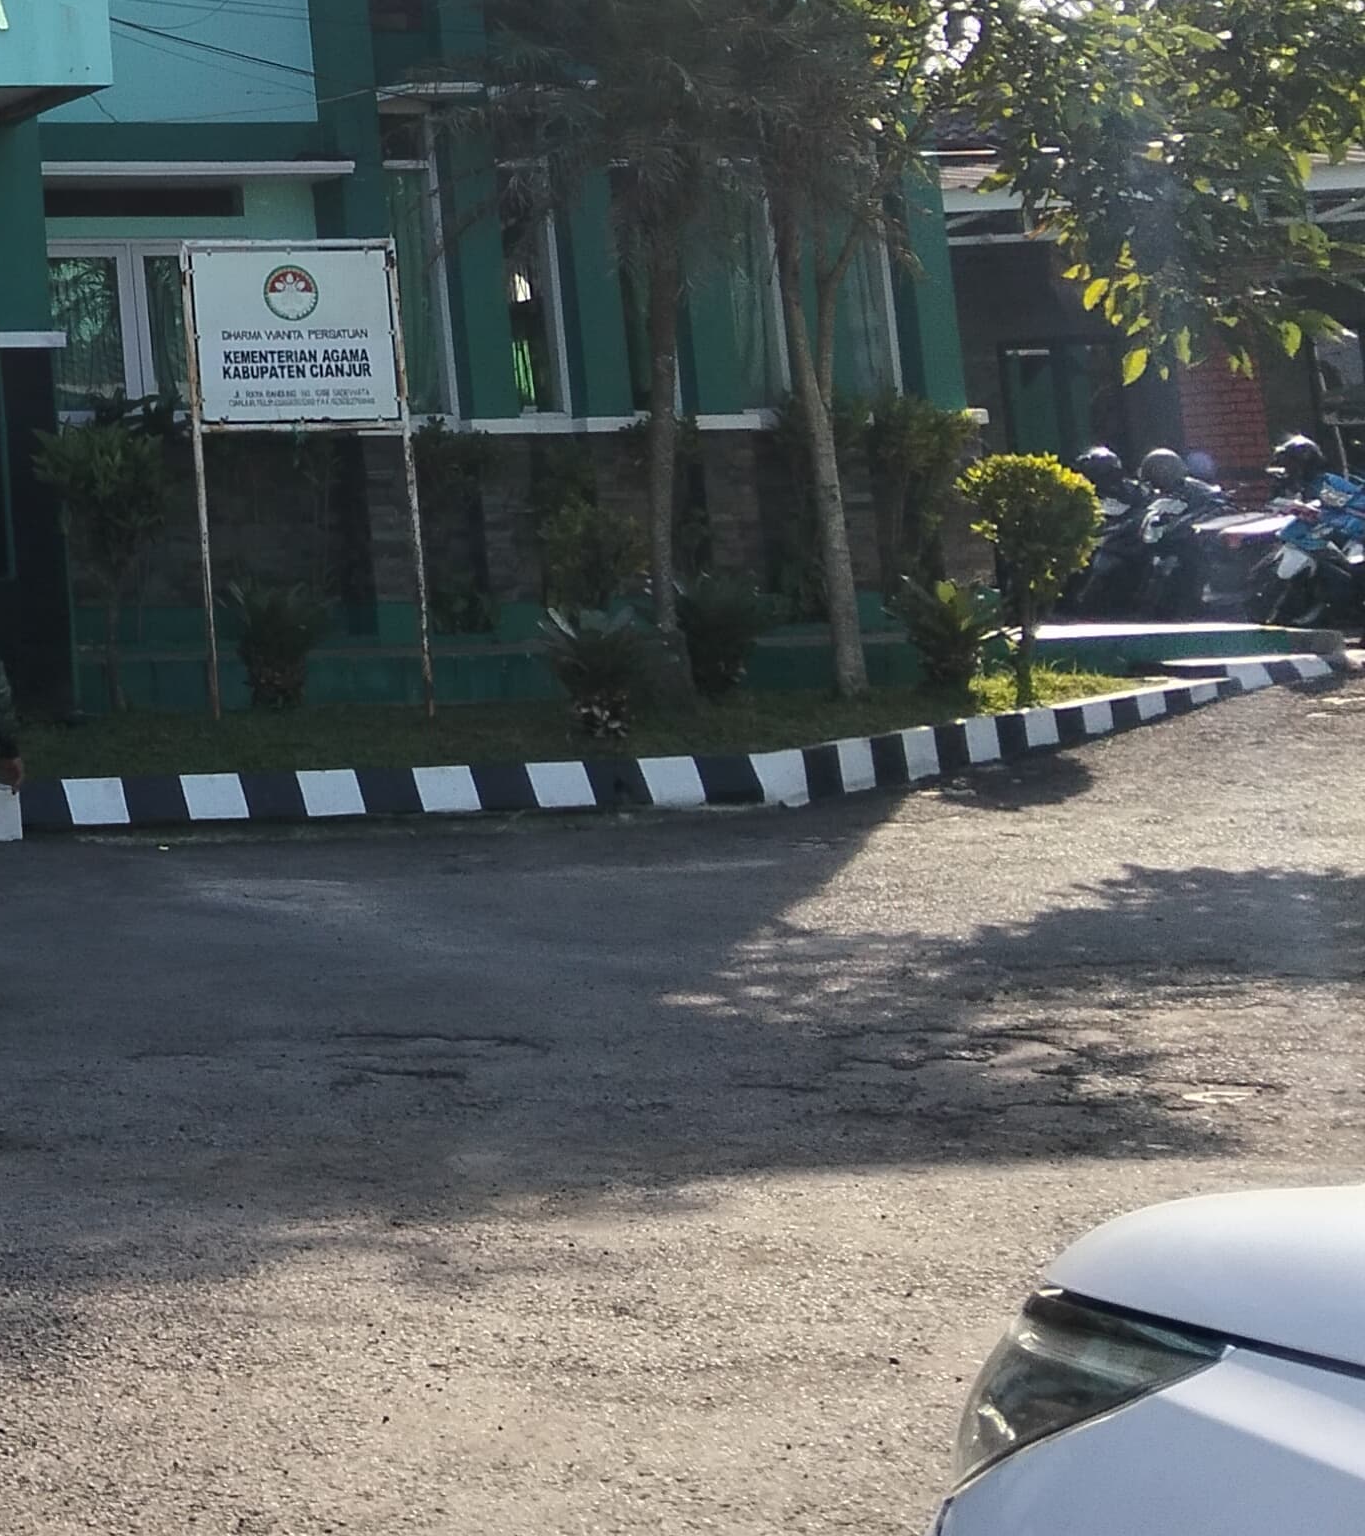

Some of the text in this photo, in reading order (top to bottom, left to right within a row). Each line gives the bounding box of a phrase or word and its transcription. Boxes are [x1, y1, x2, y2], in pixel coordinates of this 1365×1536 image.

[221, 328, 369, 341] DHARMA WANITA PERSATUAN
[222, 347, 370, 365] KEMENTERIAN AGAMA
[221, 362, 373, 380] KABUPATEN CIANJUR
